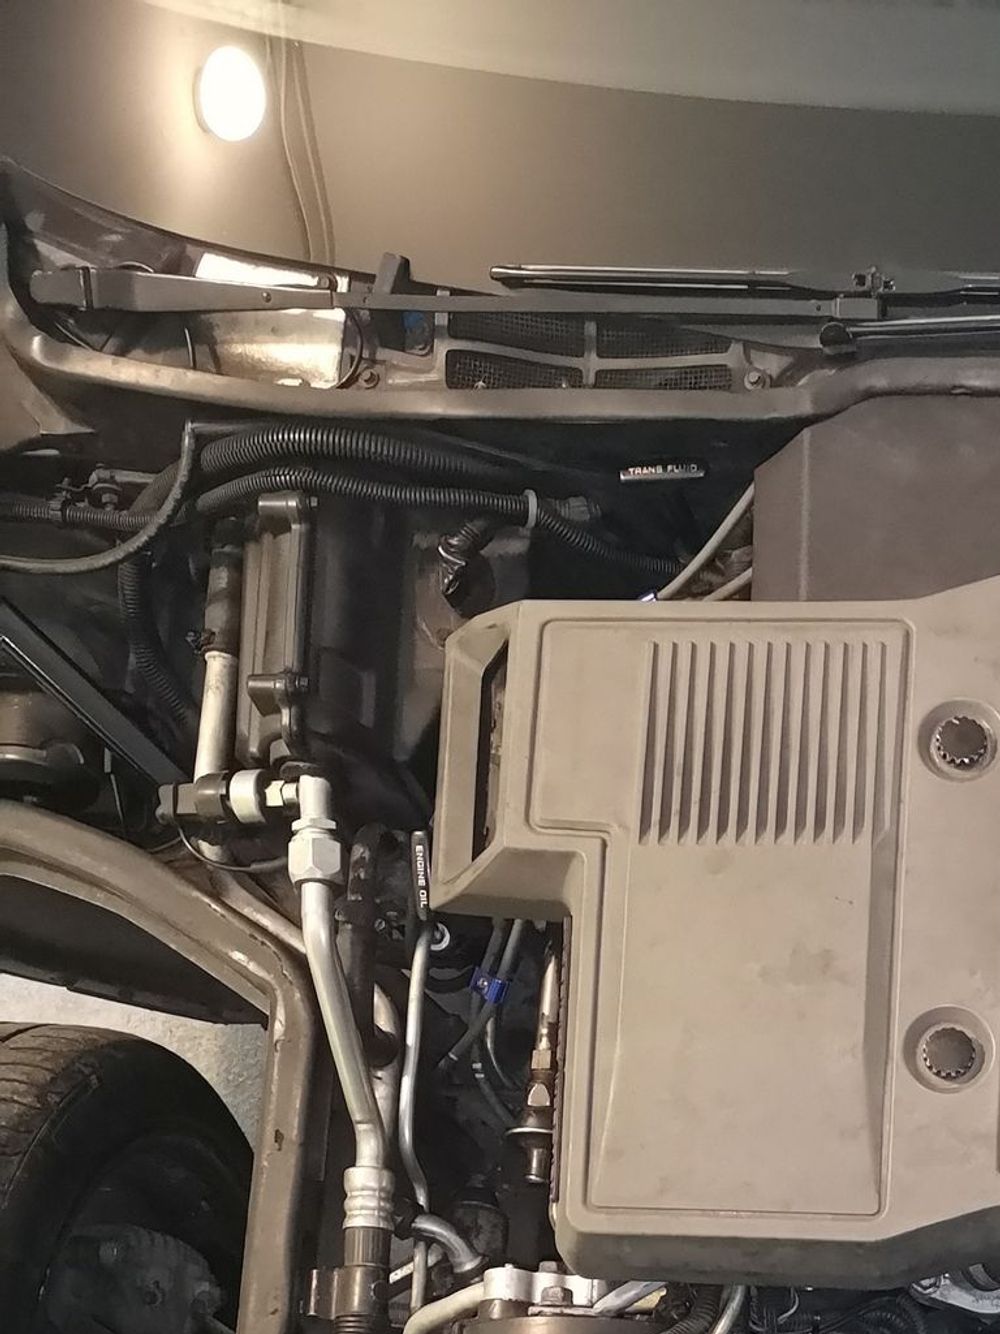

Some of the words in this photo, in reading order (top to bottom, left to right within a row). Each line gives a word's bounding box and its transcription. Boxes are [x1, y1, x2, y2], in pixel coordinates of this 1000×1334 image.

[628, 465, 663, 475] TRANS
[667, 464, 698, 473] FLUID
[416, 845, 426, 887] ENGINE
[419, 889, 428, 908] OIL
